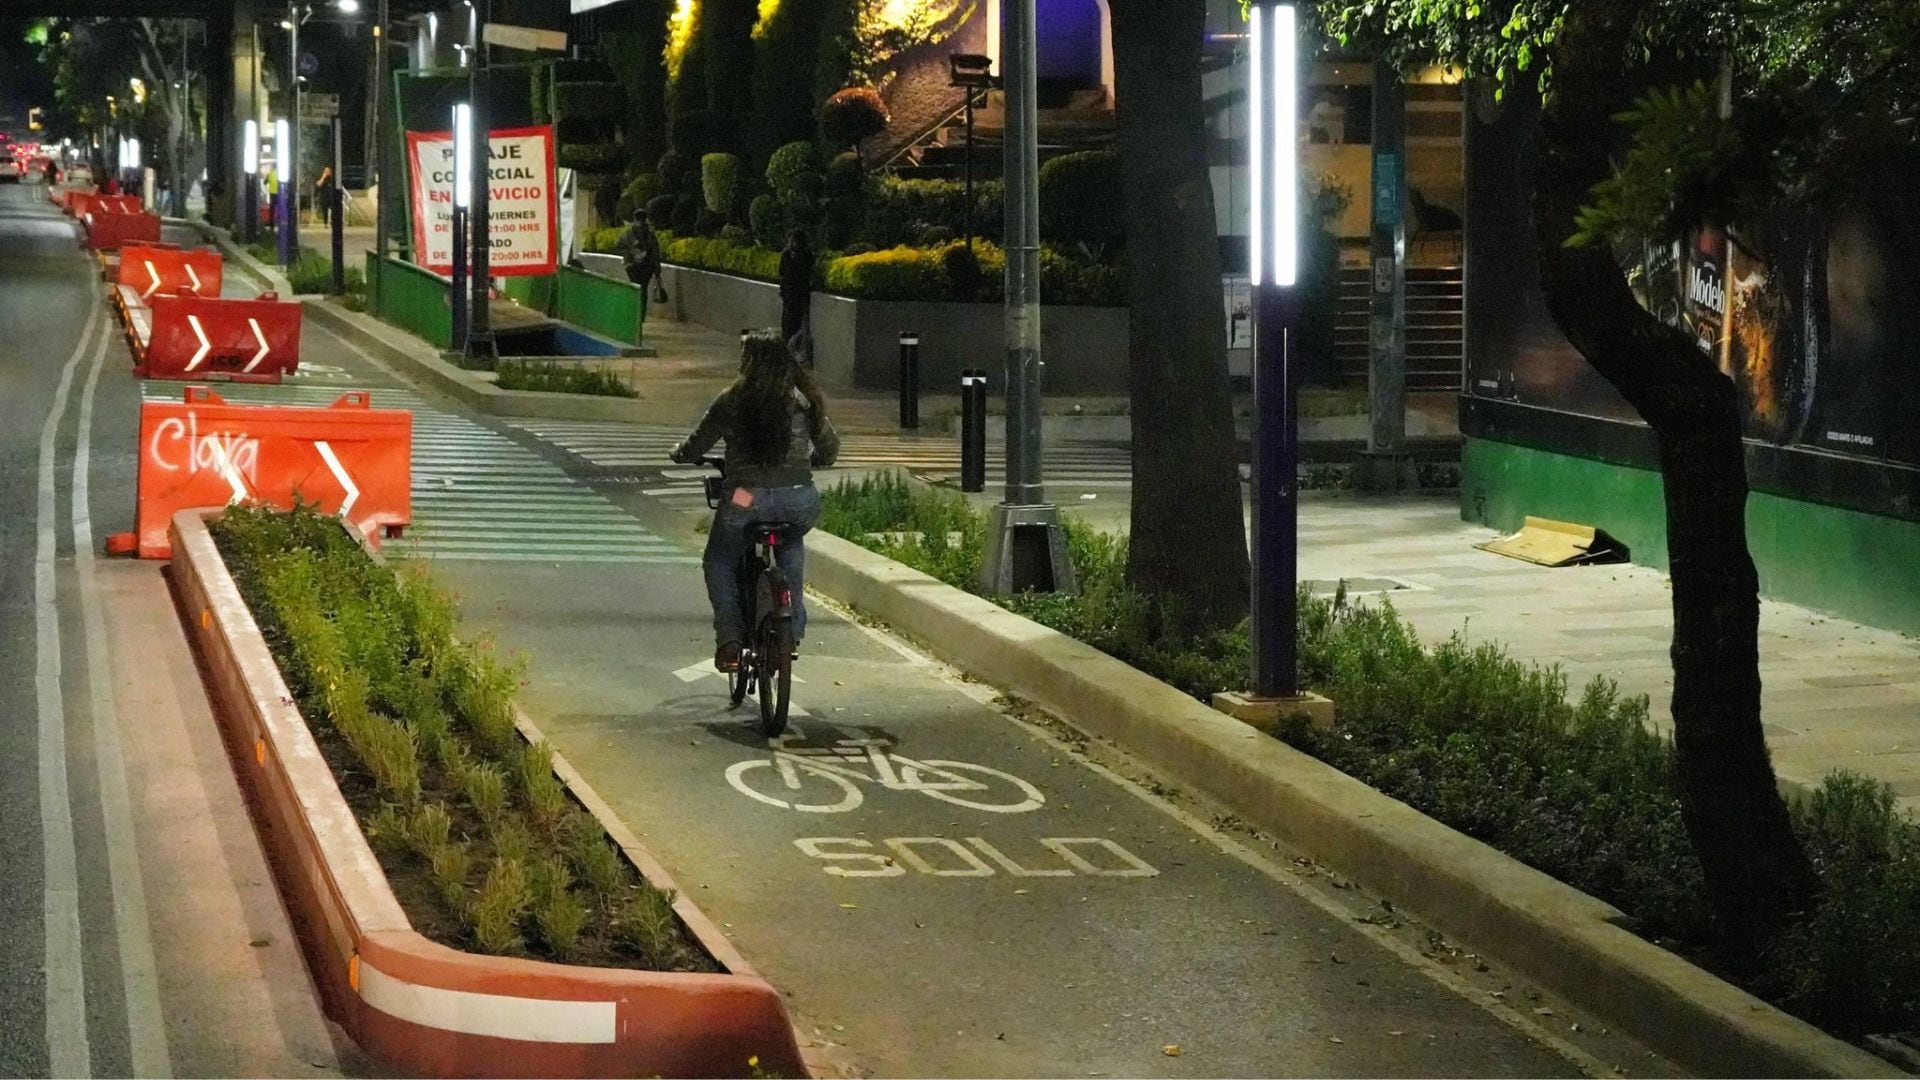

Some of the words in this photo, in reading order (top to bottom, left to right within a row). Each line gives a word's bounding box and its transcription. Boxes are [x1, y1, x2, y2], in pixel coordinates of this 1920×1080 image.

[442, 145, 522, 161] PAJE
[429, 190, 451, 203] EN
[434, 223, 449, 232] DE
[519, 222, 540, 231] HRS
[432, 250, 447, 260] DE
[491, 251, 520, 261] 20:00
[1690, 266, 1725, 314] Modelo
[793, 836, 1161, 878] SOLO
